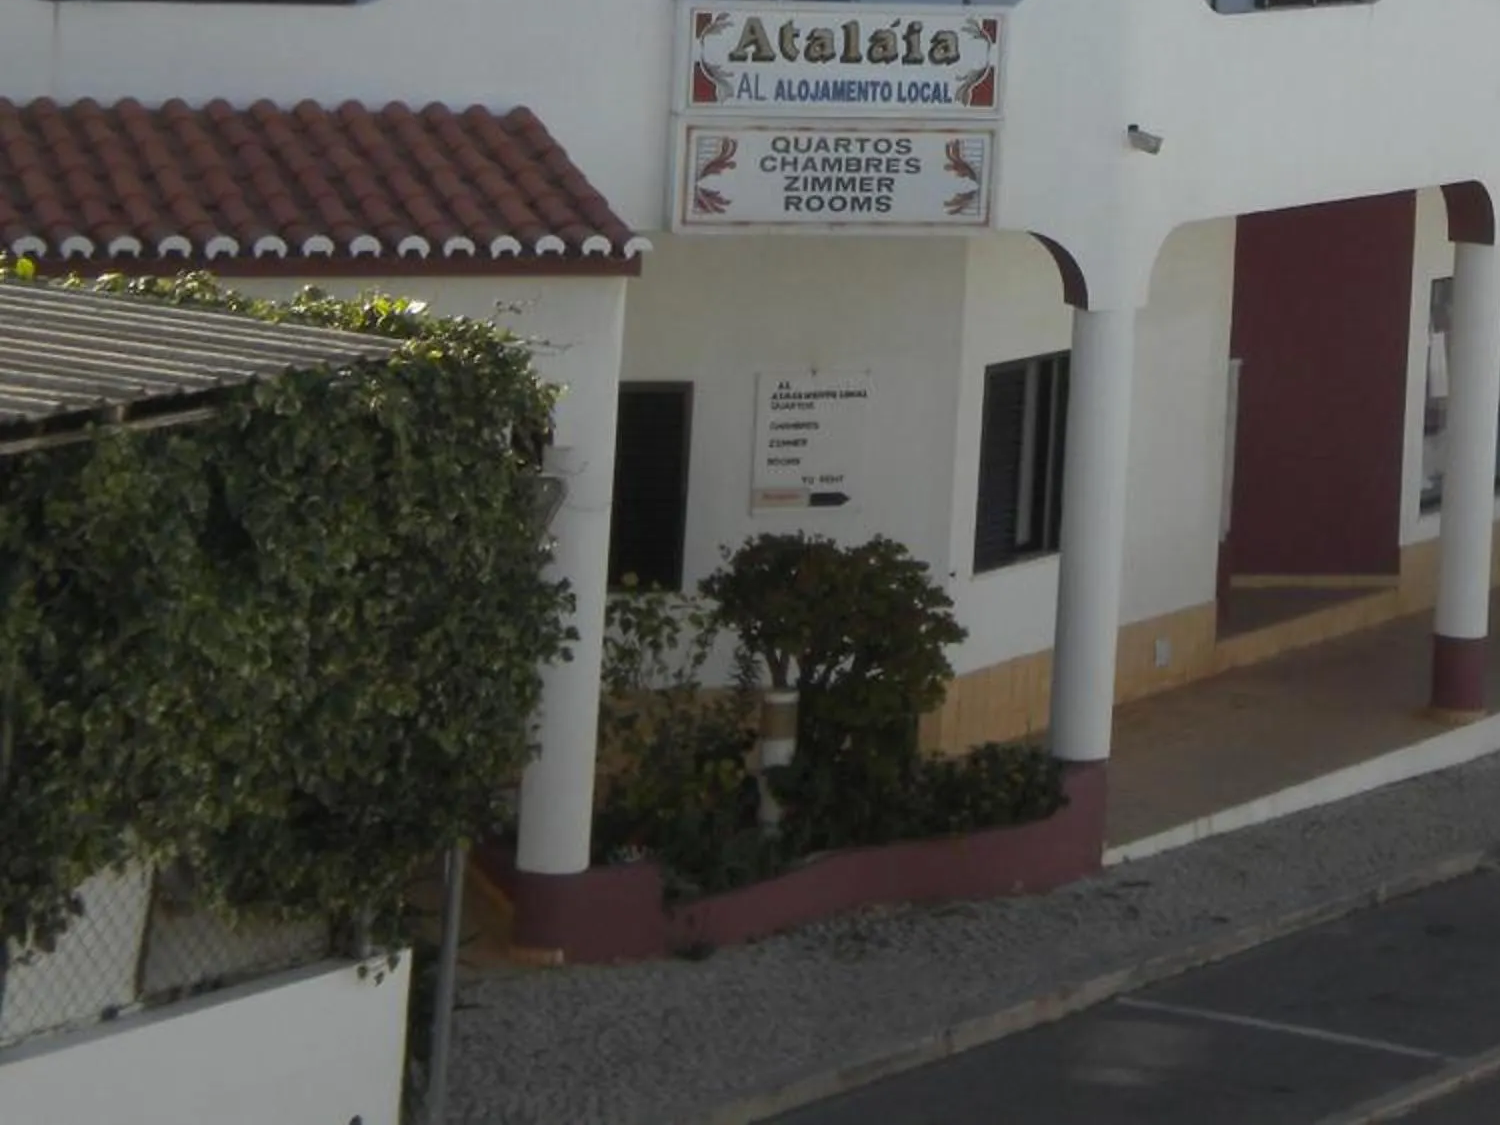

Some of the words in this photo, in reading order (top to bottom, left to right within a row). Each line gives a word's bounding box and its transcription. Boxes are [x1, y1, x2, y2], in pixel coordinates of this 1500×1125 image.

[736, 71, 767, 101] AL
[774, 78, 893, 103] ALOJAMENTO
[897, 81, 954, 104] LOCAL
[771, 136, 913, 155] QUARTOS
[759, 156, 922, 175] CHAMBRES
[783, 176, 896, 193] ZIMMER
[784, 195, 894, 213] ROOMS
